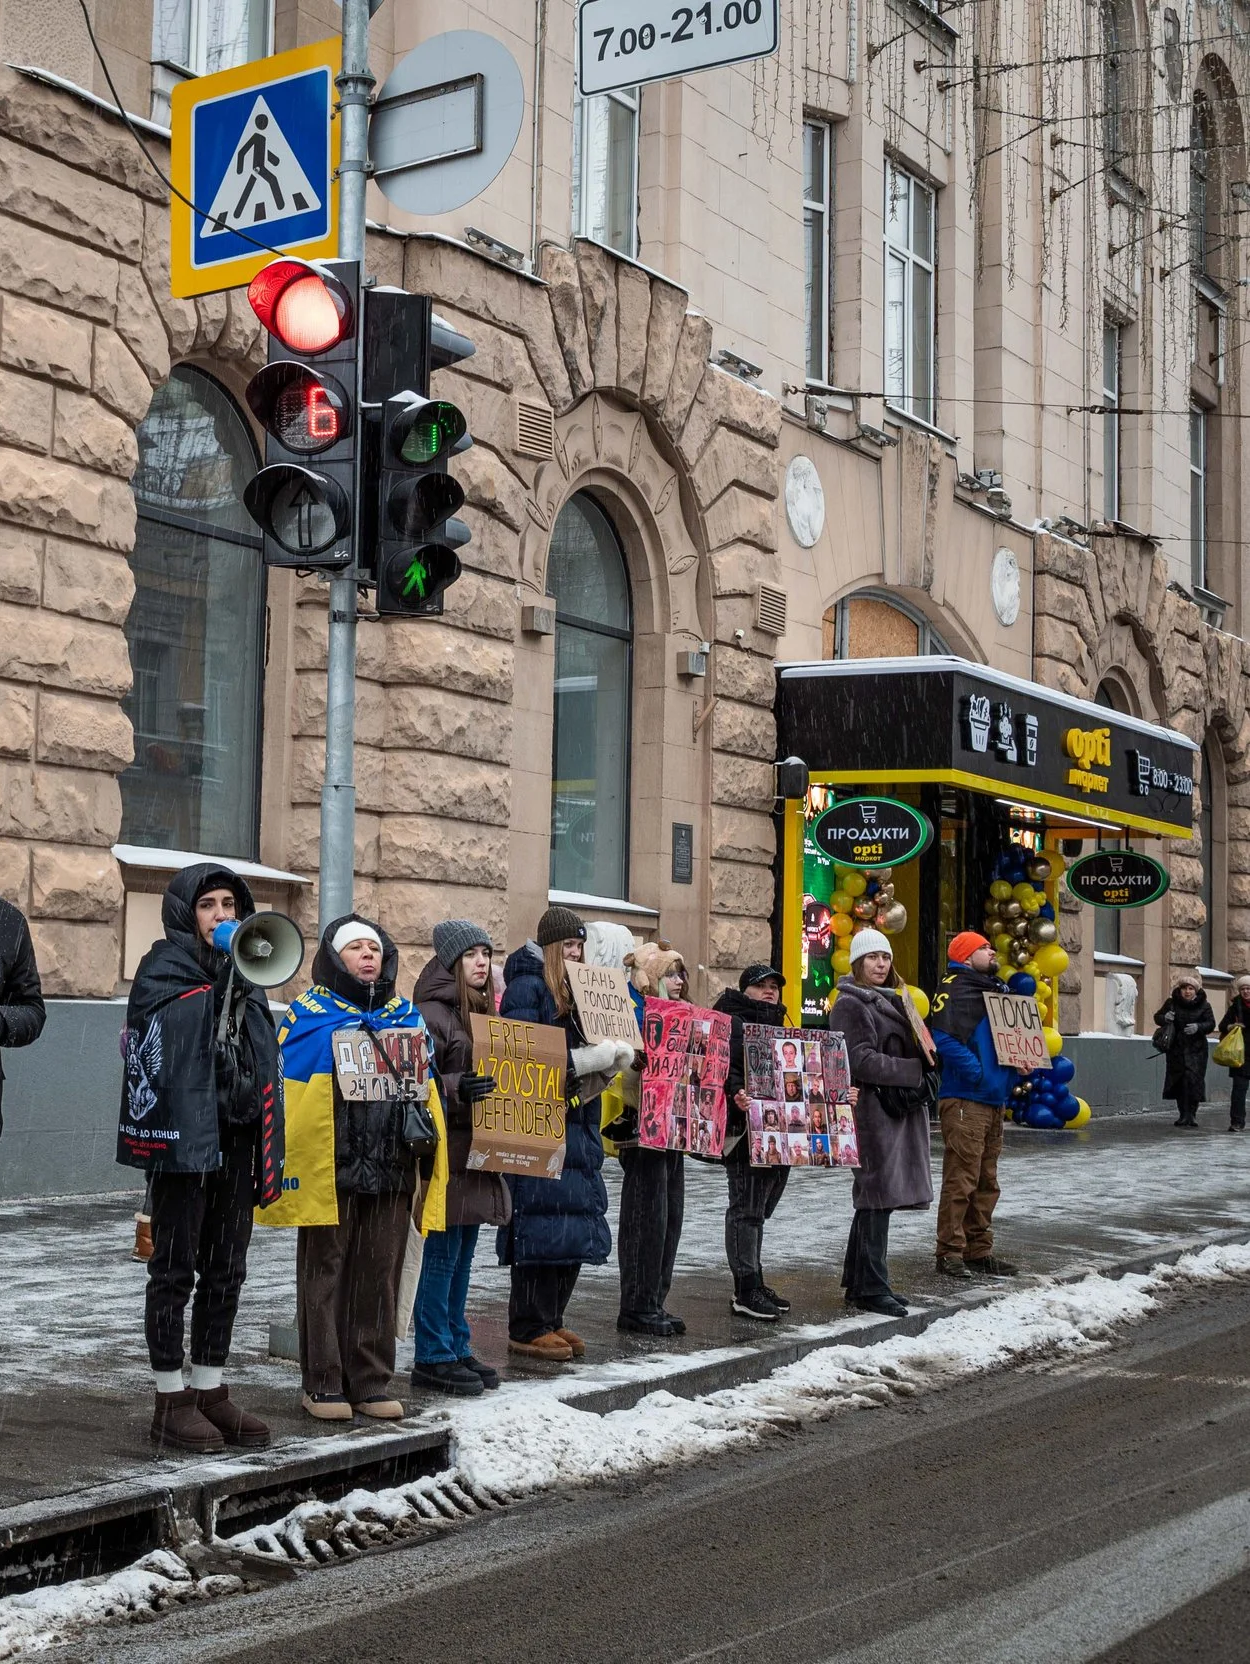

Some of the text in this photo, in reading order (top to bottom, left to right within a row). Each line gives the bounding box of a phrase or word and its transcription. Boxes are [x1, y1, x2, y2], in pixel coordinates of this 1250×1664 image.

[593, 0, 762, 62] 7.00-21.00
[1064, 727, 1112, 770] opti
[1067, 768, 1110, 794] маркет
[827, 827, 909, 841] ПРОДУКТИ
[853, 843, 883, 856] opti
[1081, 875, 1152, 887] ПРОДУКТИ
[1103, 887, 1130, 899] opti
[577, 968, 616, 990] СТАНЬ
[583, 990, 630, 1014] ГОЛОСОМ
[989, 996, 1042, 1031] ПОЛОН
[582, 1011, 636, 1041] ПОЛОНЕНИХ
[488, 1019, 537, 1062] FREE
[997, 1032, 1044, 1057] ПЕКЛО
[350, 1078, 367, 1101] 24
[473, 1096, 566, 1141] DEFENDERS
[152, 1130, 180, 1139] КІНЦЯ
